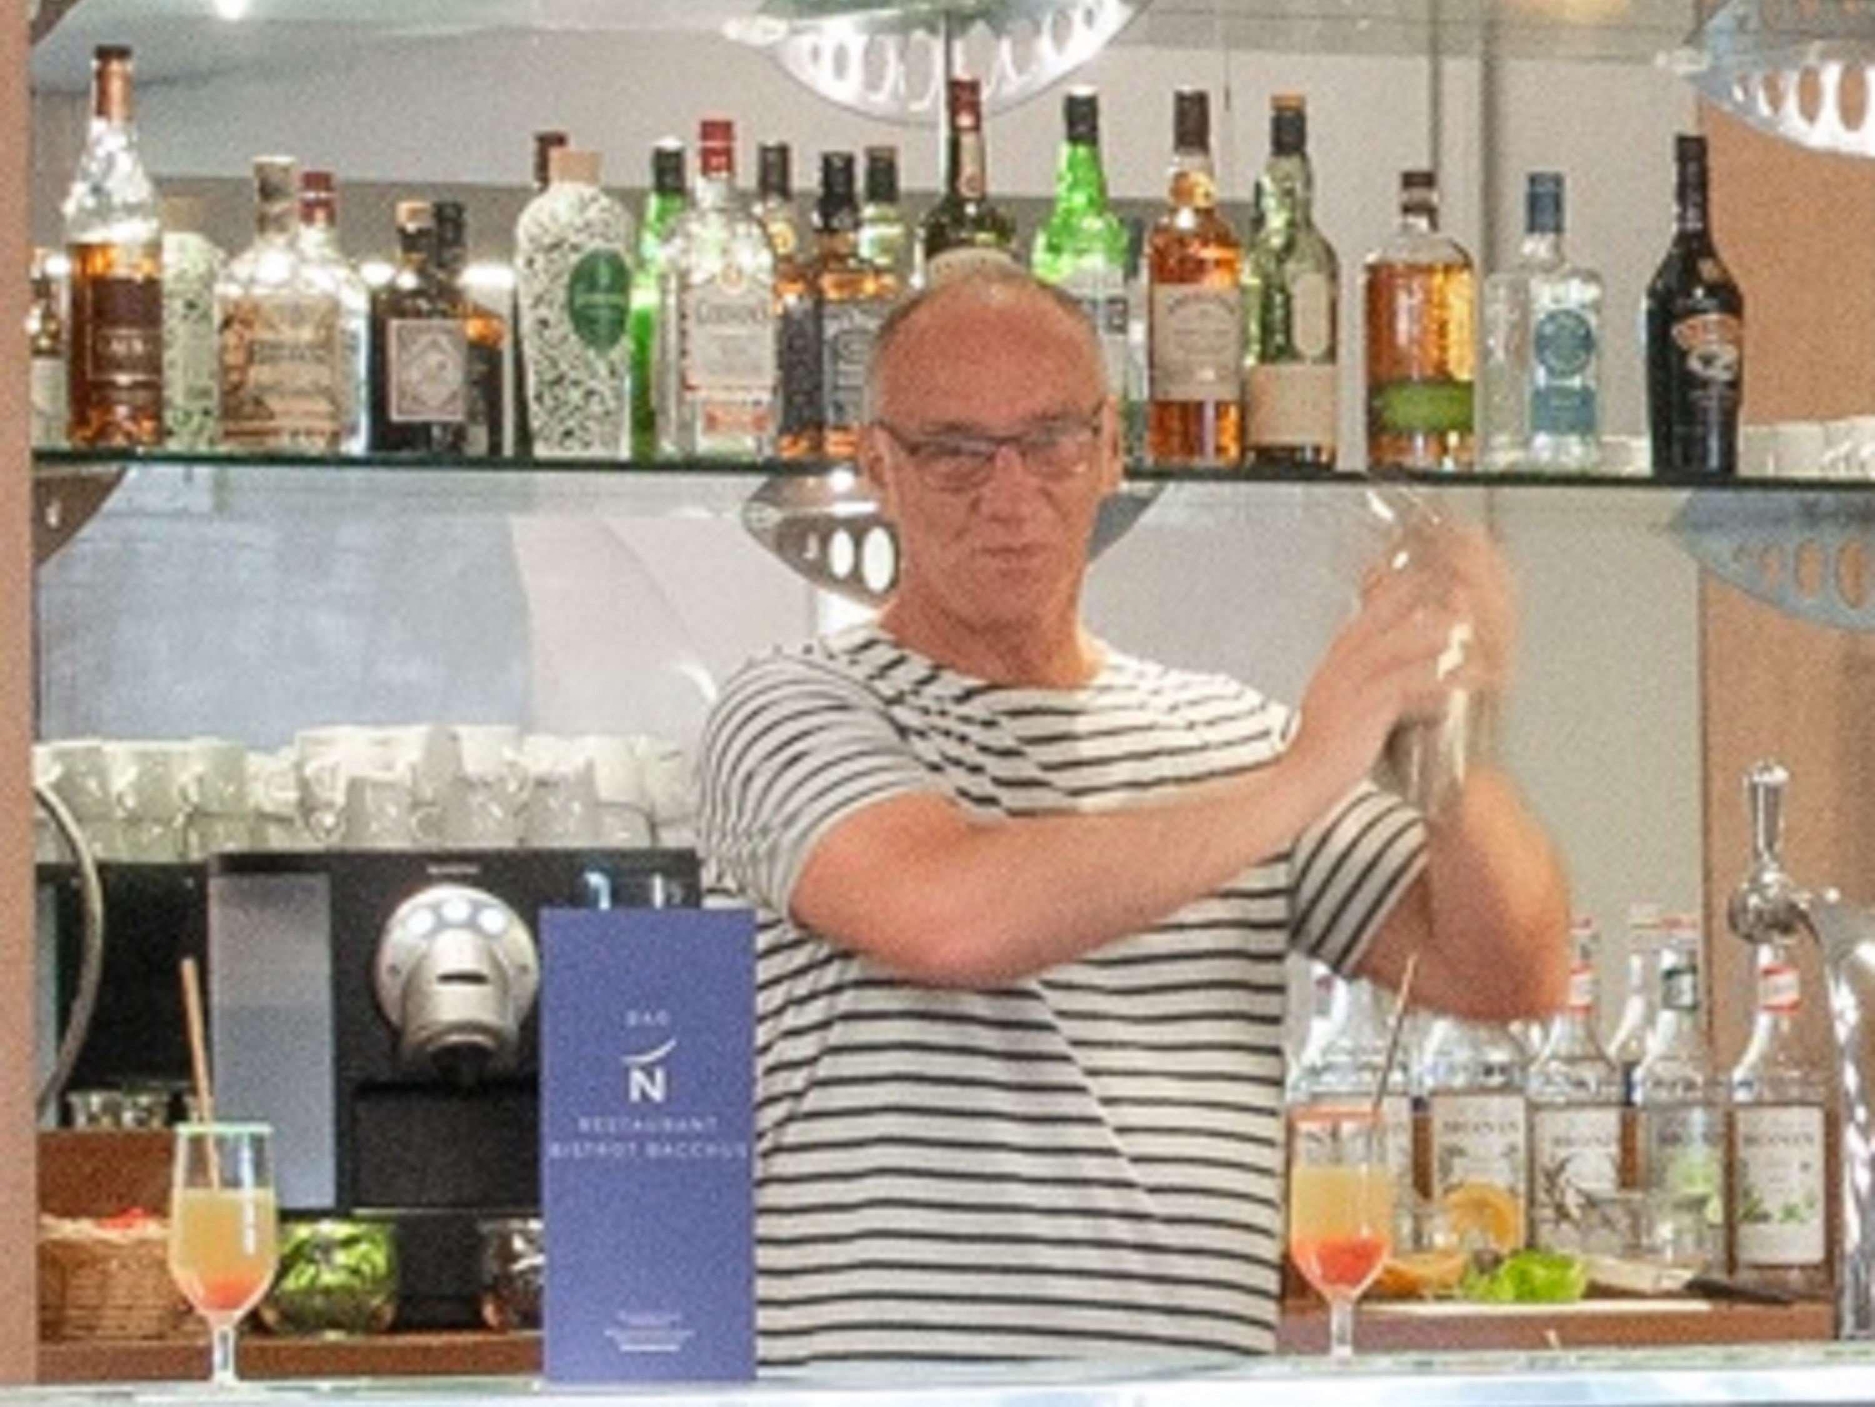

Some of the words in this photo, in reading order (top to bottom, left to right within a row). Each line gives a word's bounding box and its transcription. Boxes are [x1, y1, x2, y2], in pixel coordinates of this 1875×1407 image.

[628, 1066, 667, 1102] N
[578, 1116, 718, 1132] RESTAURANT
[549, 1142, 637, 1158] BISTROT
[645, 1142, 747, 1158] BACCHUS
